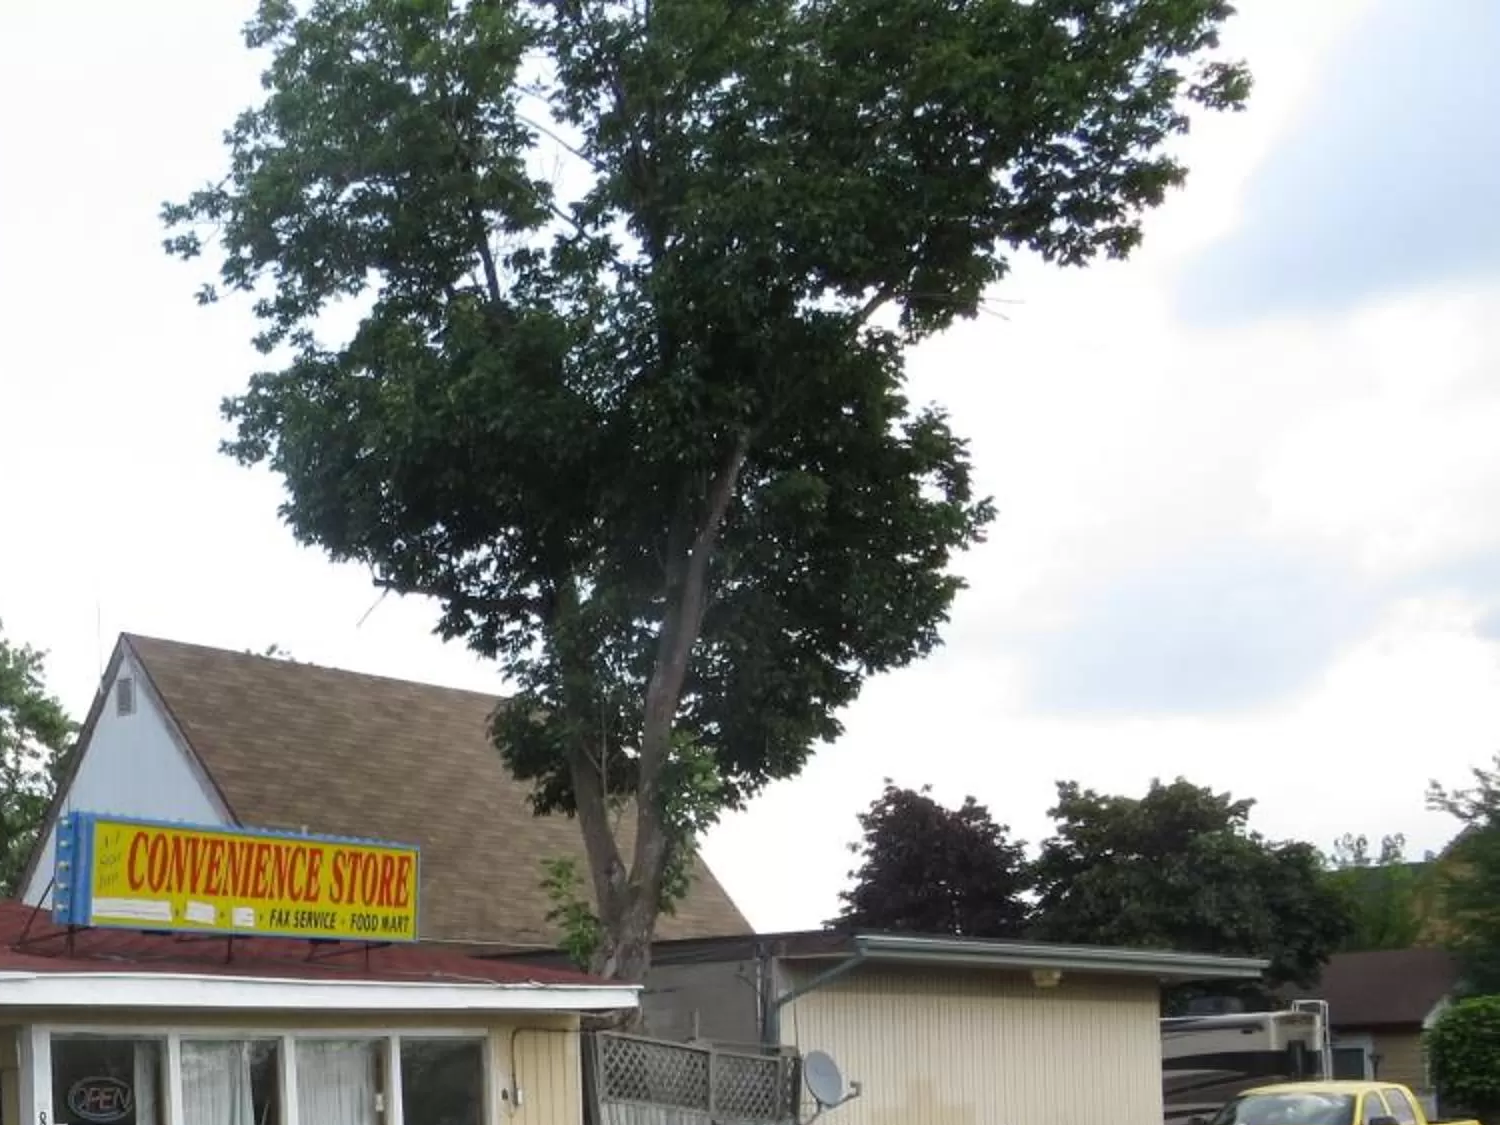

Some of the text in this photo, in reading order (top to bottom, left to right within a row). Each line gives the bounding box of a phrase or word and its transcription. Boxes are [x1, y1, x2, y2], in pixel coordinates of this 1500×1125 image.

[127, 831, 412, 908] CONVENIENCE STORE
[269, 908, 410, 933] FAX SERVICE FOOD MART
[78, 1087, 132, 1111] OPEN
